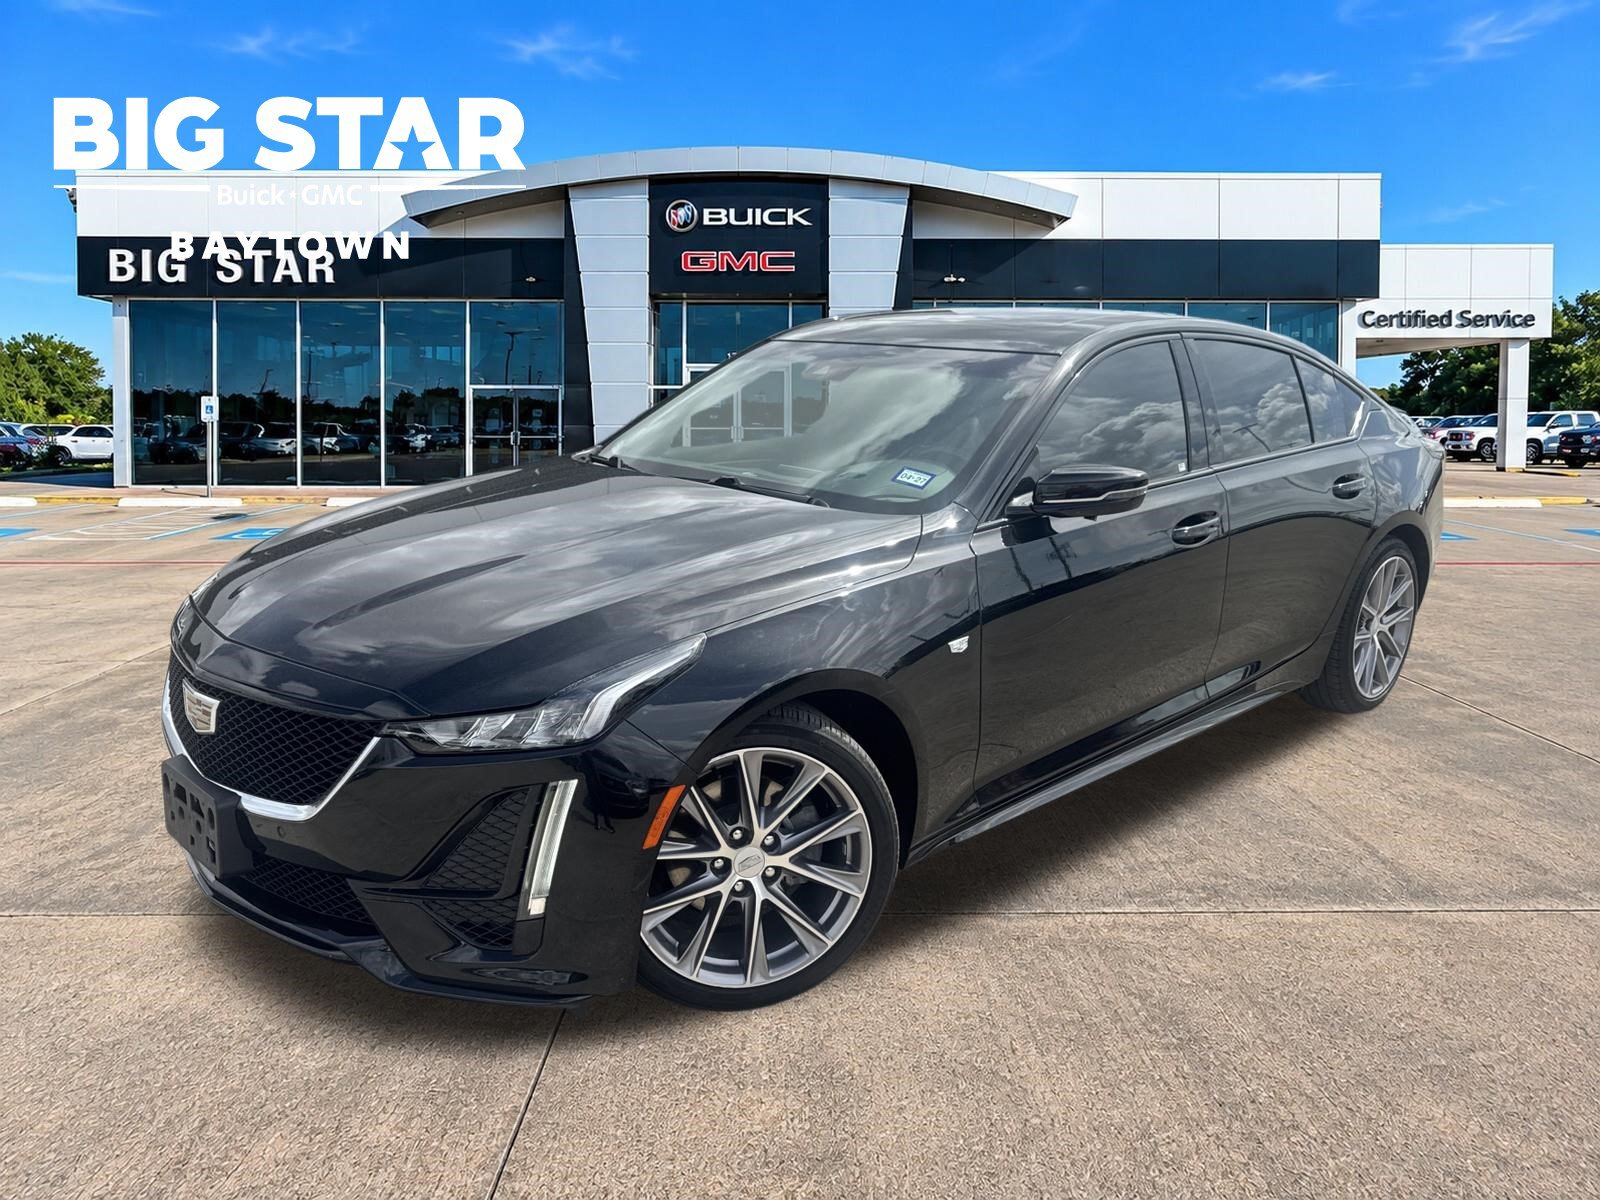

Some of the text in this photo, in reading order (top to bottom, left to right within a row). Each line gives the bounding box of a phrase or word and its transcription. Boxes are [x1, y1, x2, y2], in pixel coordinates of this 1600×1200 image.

[702, 207, 813, 226] BUICK
[108, 248, 336, 284] BIG STAR
[681, 251, 796, 272] GMC
[1360, 310, 1536, 328] Certified Service
